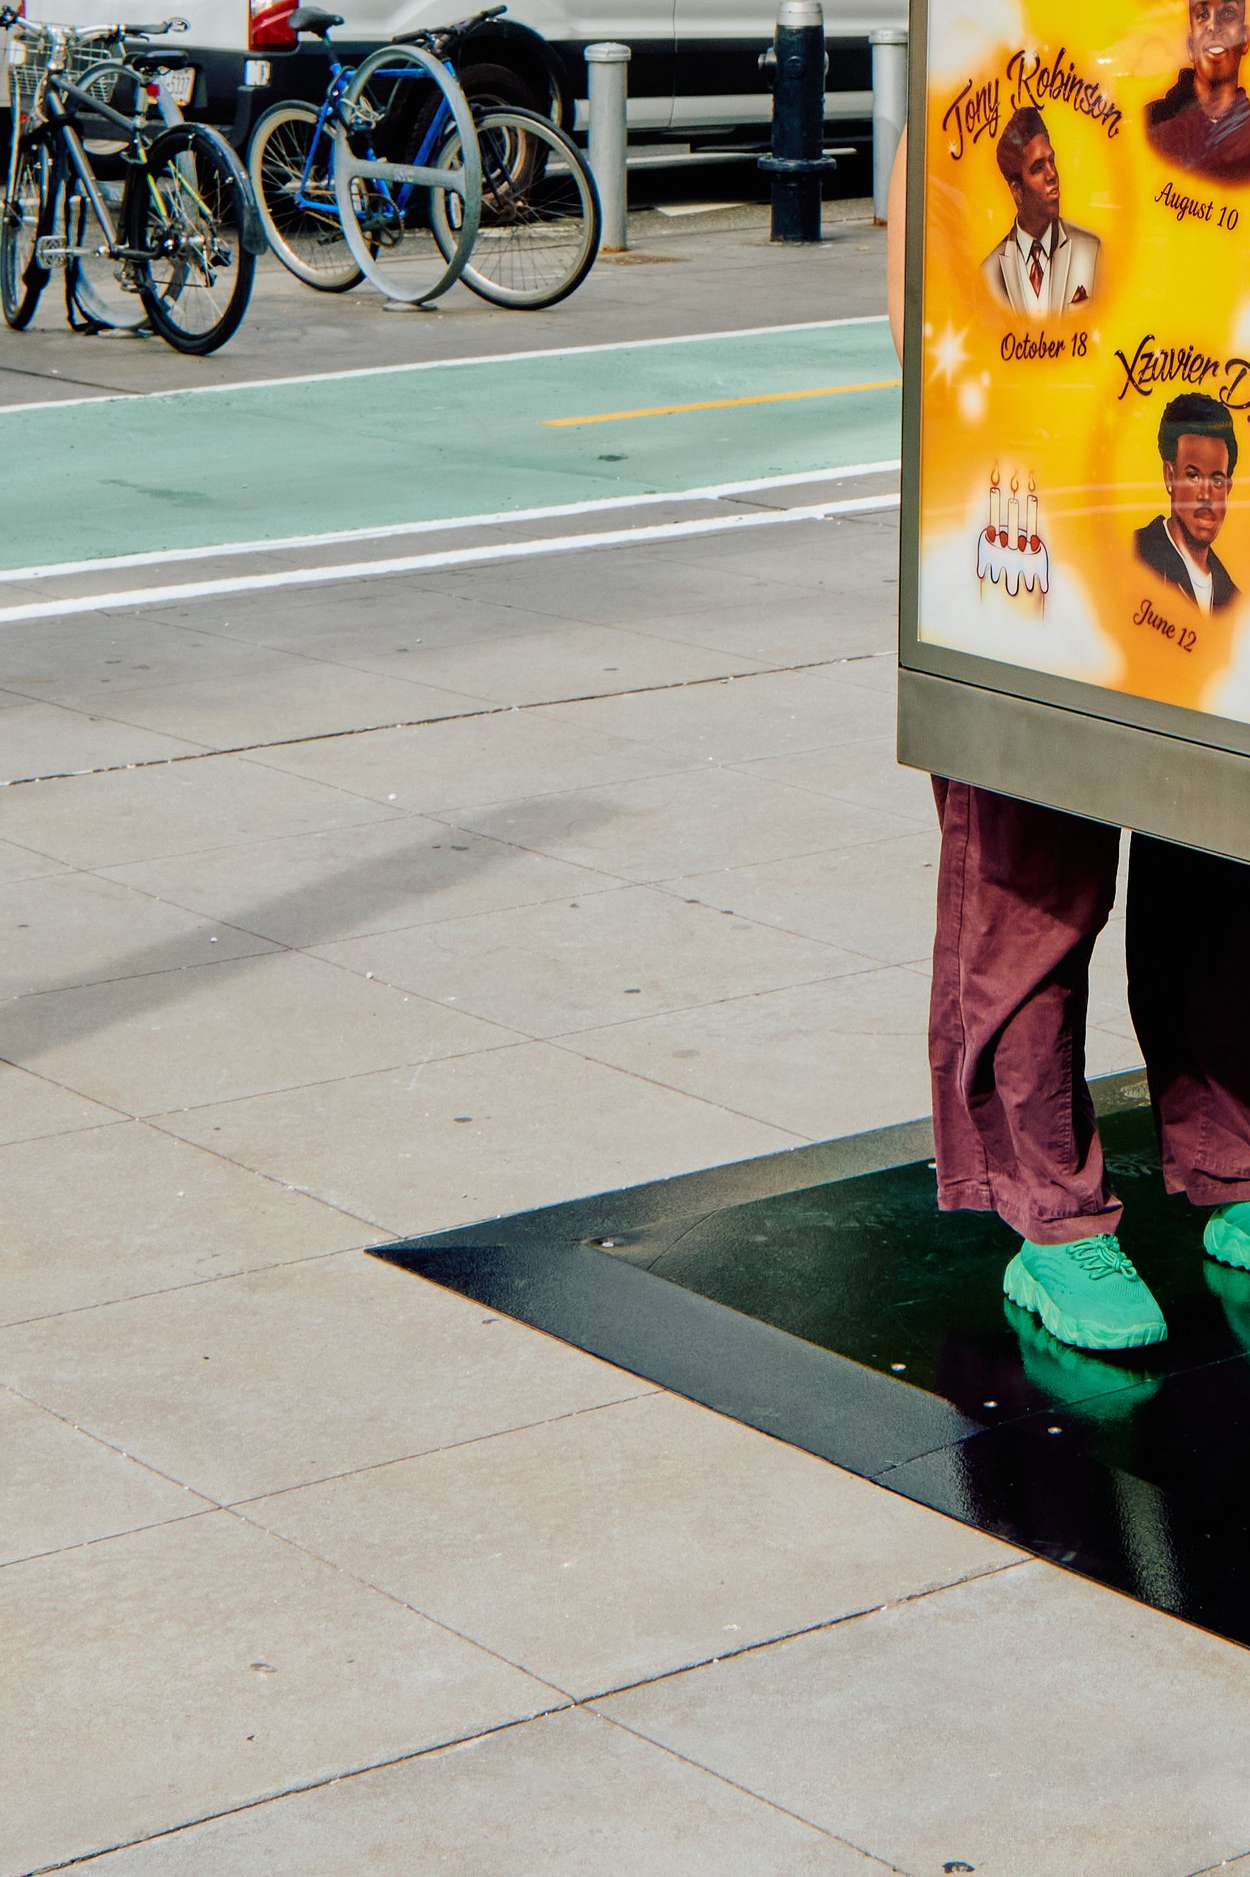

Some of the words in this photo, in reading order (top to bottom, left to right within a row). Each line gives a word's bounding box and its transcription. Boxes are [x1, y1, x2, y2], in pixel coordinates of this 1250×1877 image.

[942, 74, 1003, 160] Tony
[1006, 46, 1123, 139] Robinson
[1154, 181, 1215, 222] August
[1217, 205, 1240, 231] 10
[1000, 331, 1067, 362] October
[1070, 330, 1088, 358] 18
[1114, 334, 1222, 400] Xzavier
[1132, 599, 1177, 639] June
[1178, 630, 1198, 653] 12
